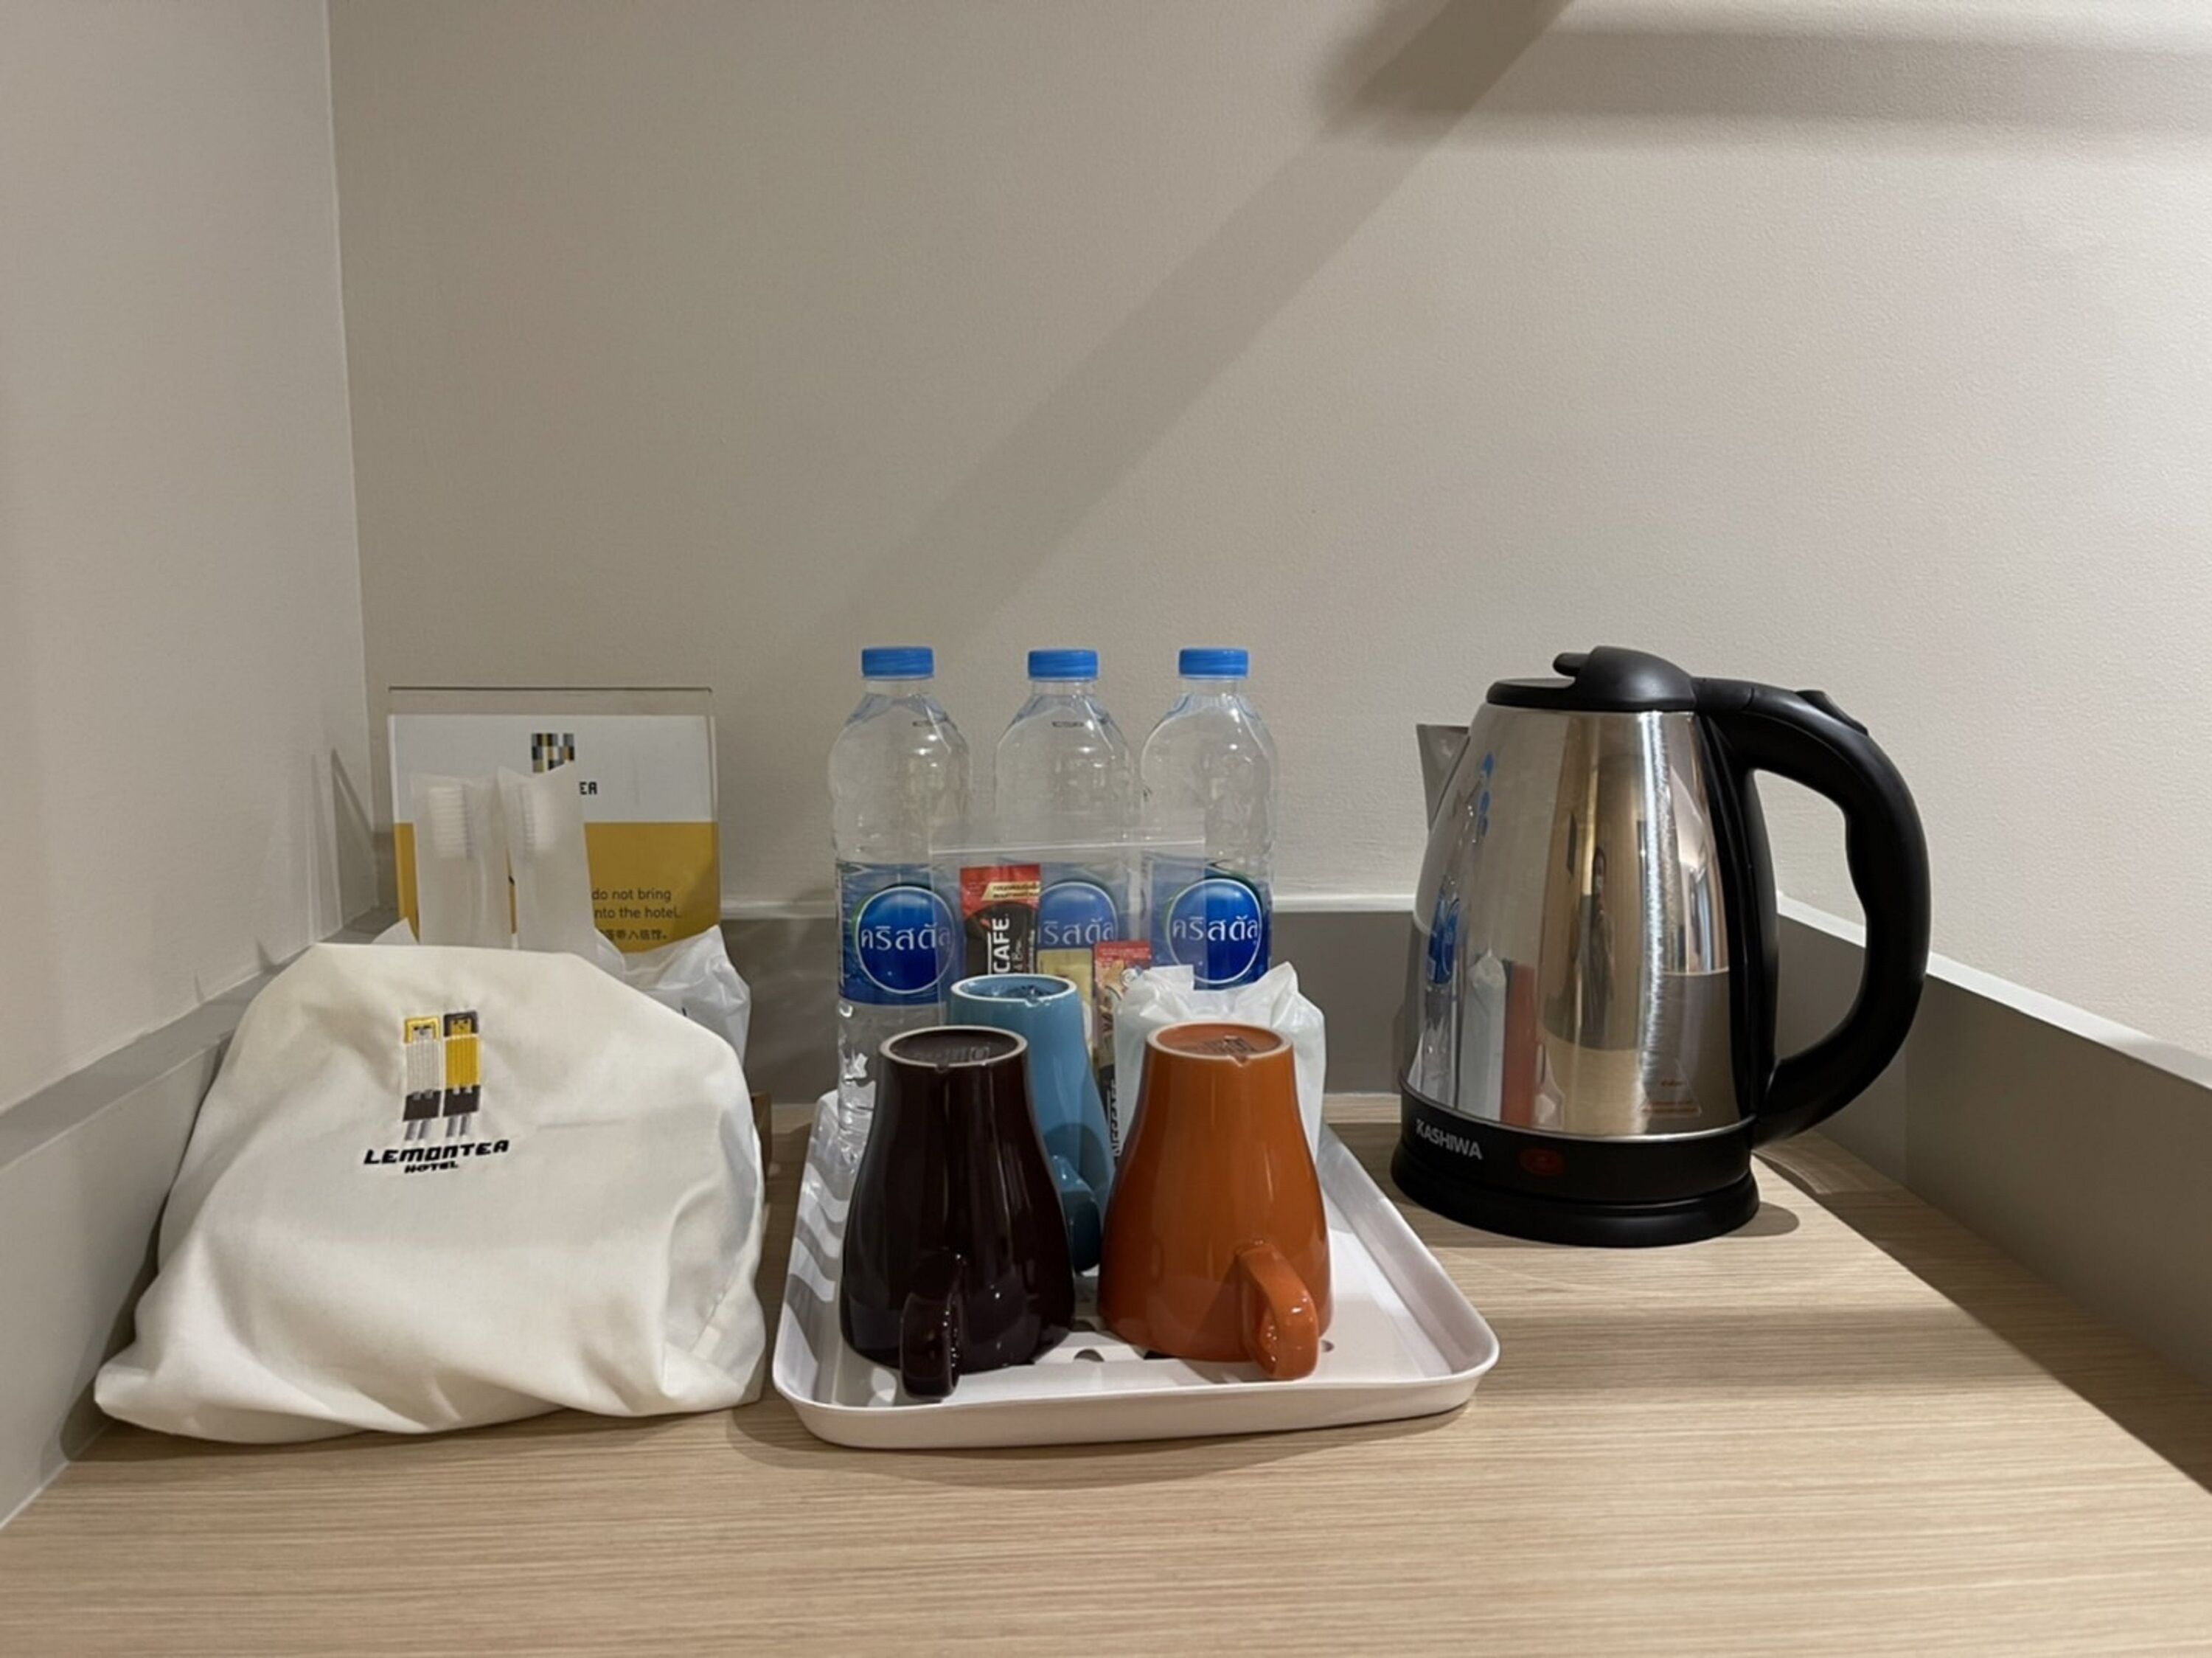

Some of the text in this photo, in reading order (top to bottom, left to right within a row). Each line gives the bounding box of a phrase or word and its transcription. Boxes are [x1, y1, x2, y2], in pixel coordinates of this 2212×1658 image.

[579, 781, 598, 795] EA
[592, 887, 672, 903] do not bring
[594, 907, 616, 919] nto
[620, 906, 641, 919] the
[1037, 917, 1108, 946] ริสตัล
[1415, 1118, 1484, 1161] KASHIWA
[364, 1140, 509, 1164] LEMONTEA
[404, 1160, 459, 1174] HOTEL
